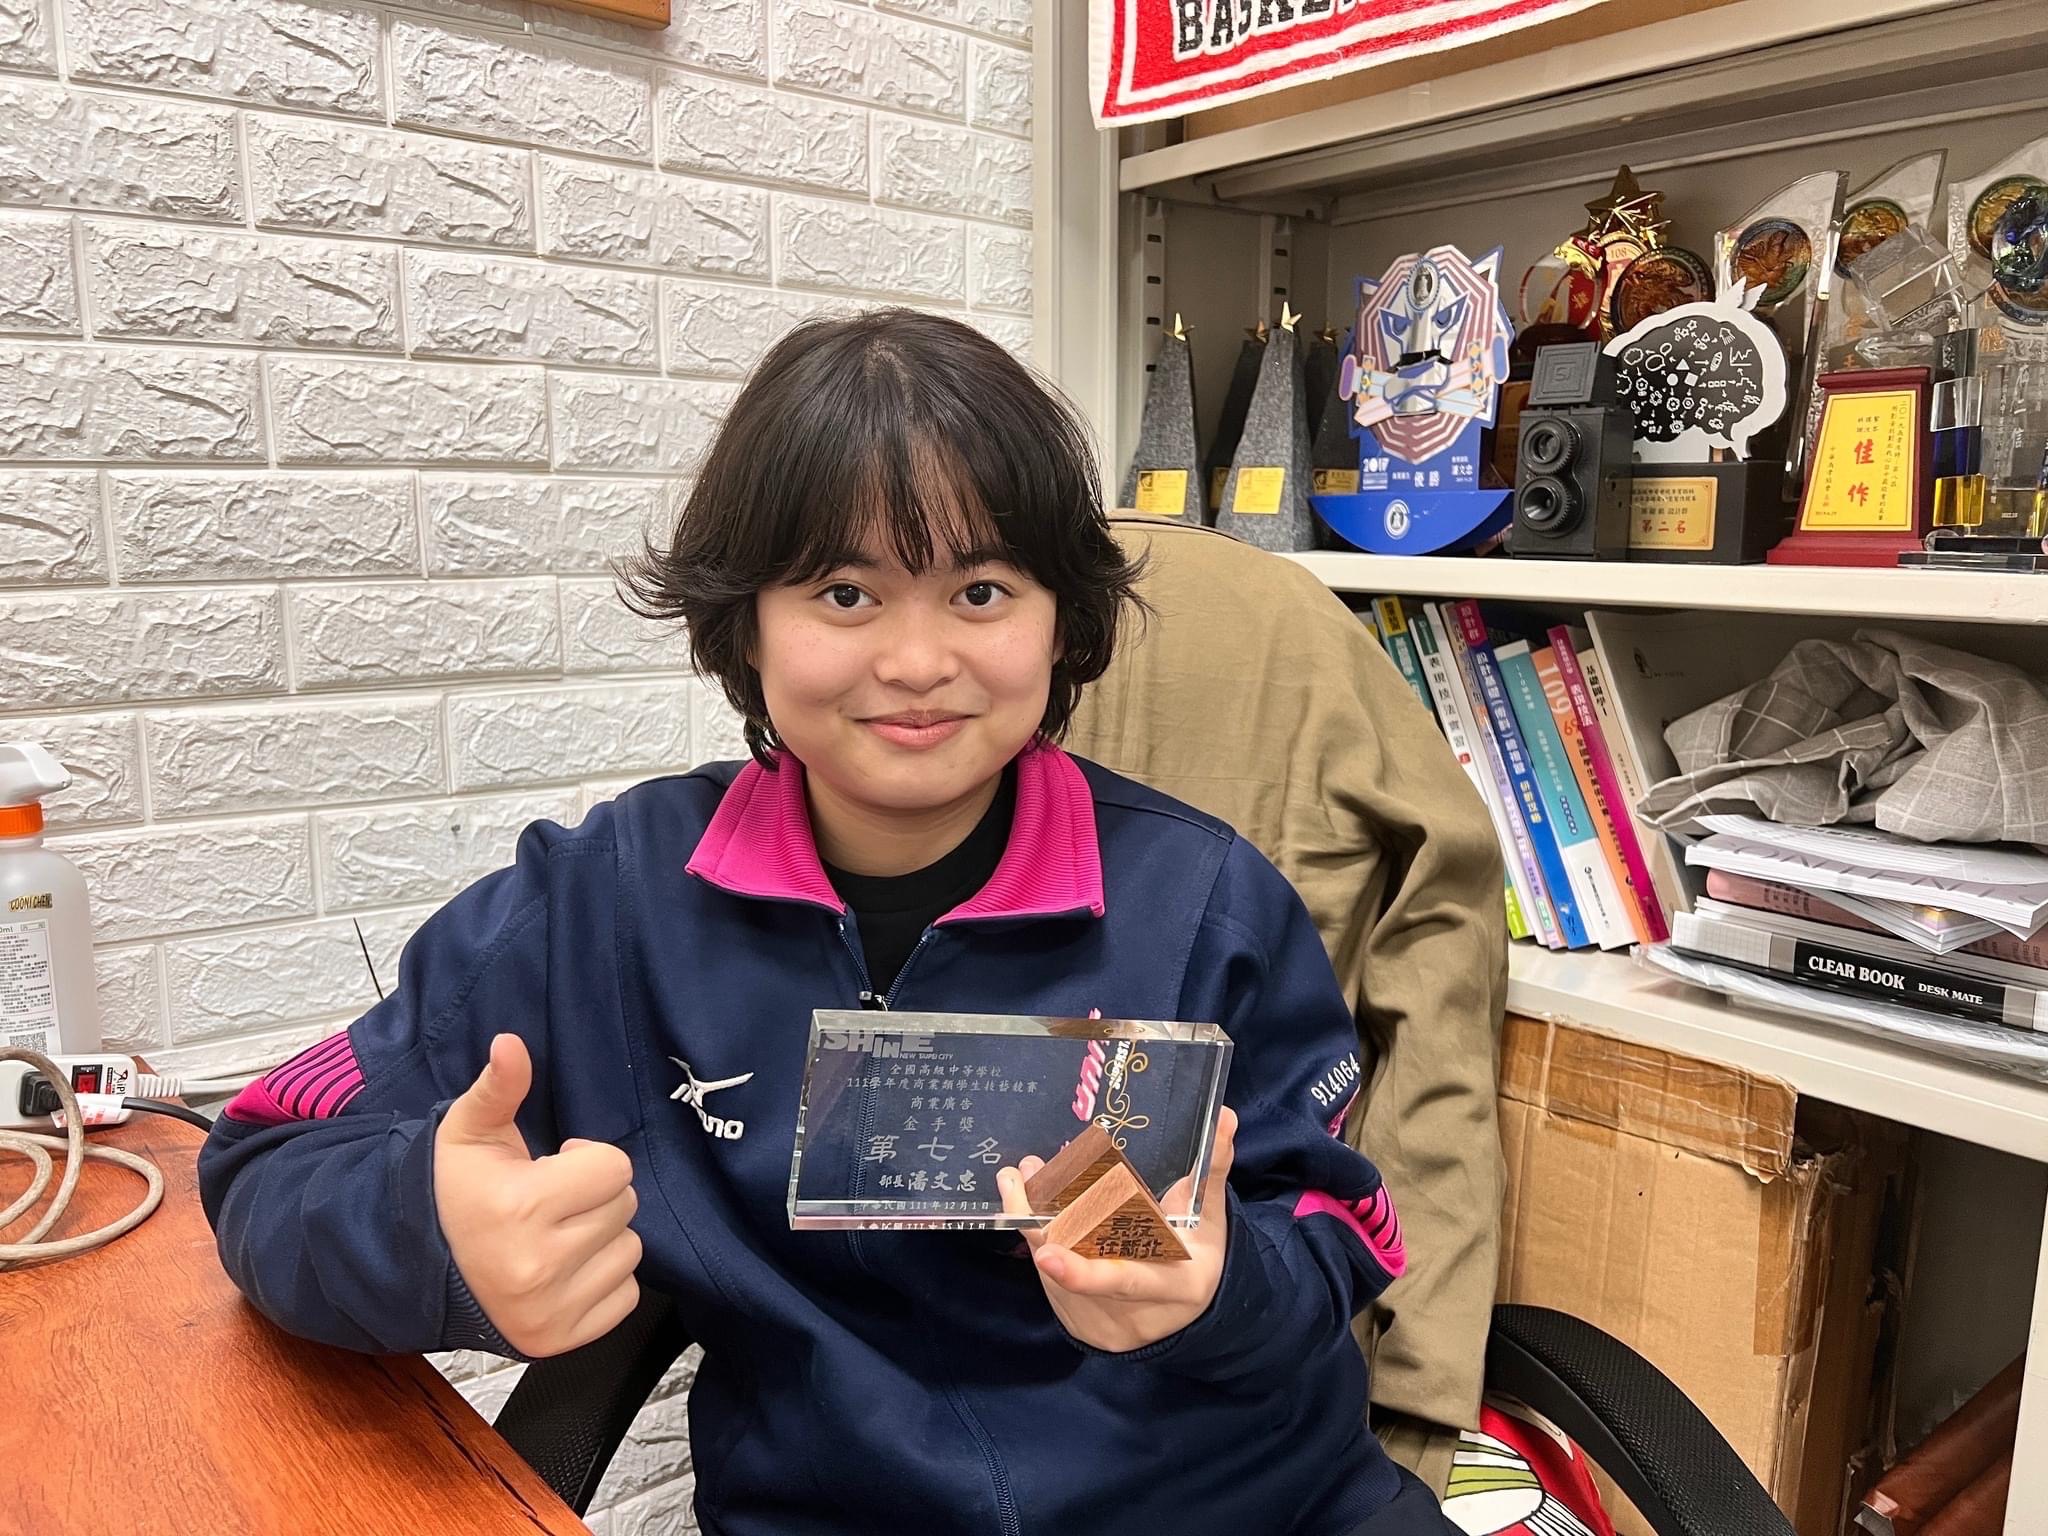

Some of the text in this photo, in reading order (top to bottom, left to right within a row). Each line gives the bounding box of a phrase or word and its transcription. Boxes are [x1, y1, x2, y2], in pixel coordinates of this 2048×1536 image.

[1847, 438, 1875, 507] 佳作
[1461, 606, 1481, 641] 設計群
[1538, 661, 1572, 715] 109
[1808, 955, 1984, 1005] CLEAR BOOK DESK MATE
[889, 1063, 1002, 1079] 全國高級中等學校
[1109, 1040, 1130, 1090] SUPERST
[1310, 1051, 1361, 1107] 914064
[903, 1115, 975, 1133] 金手獎
[910, 1095, 973, 1111] 商業廣告
[864, 1134, 1001, 1165] 第七名
